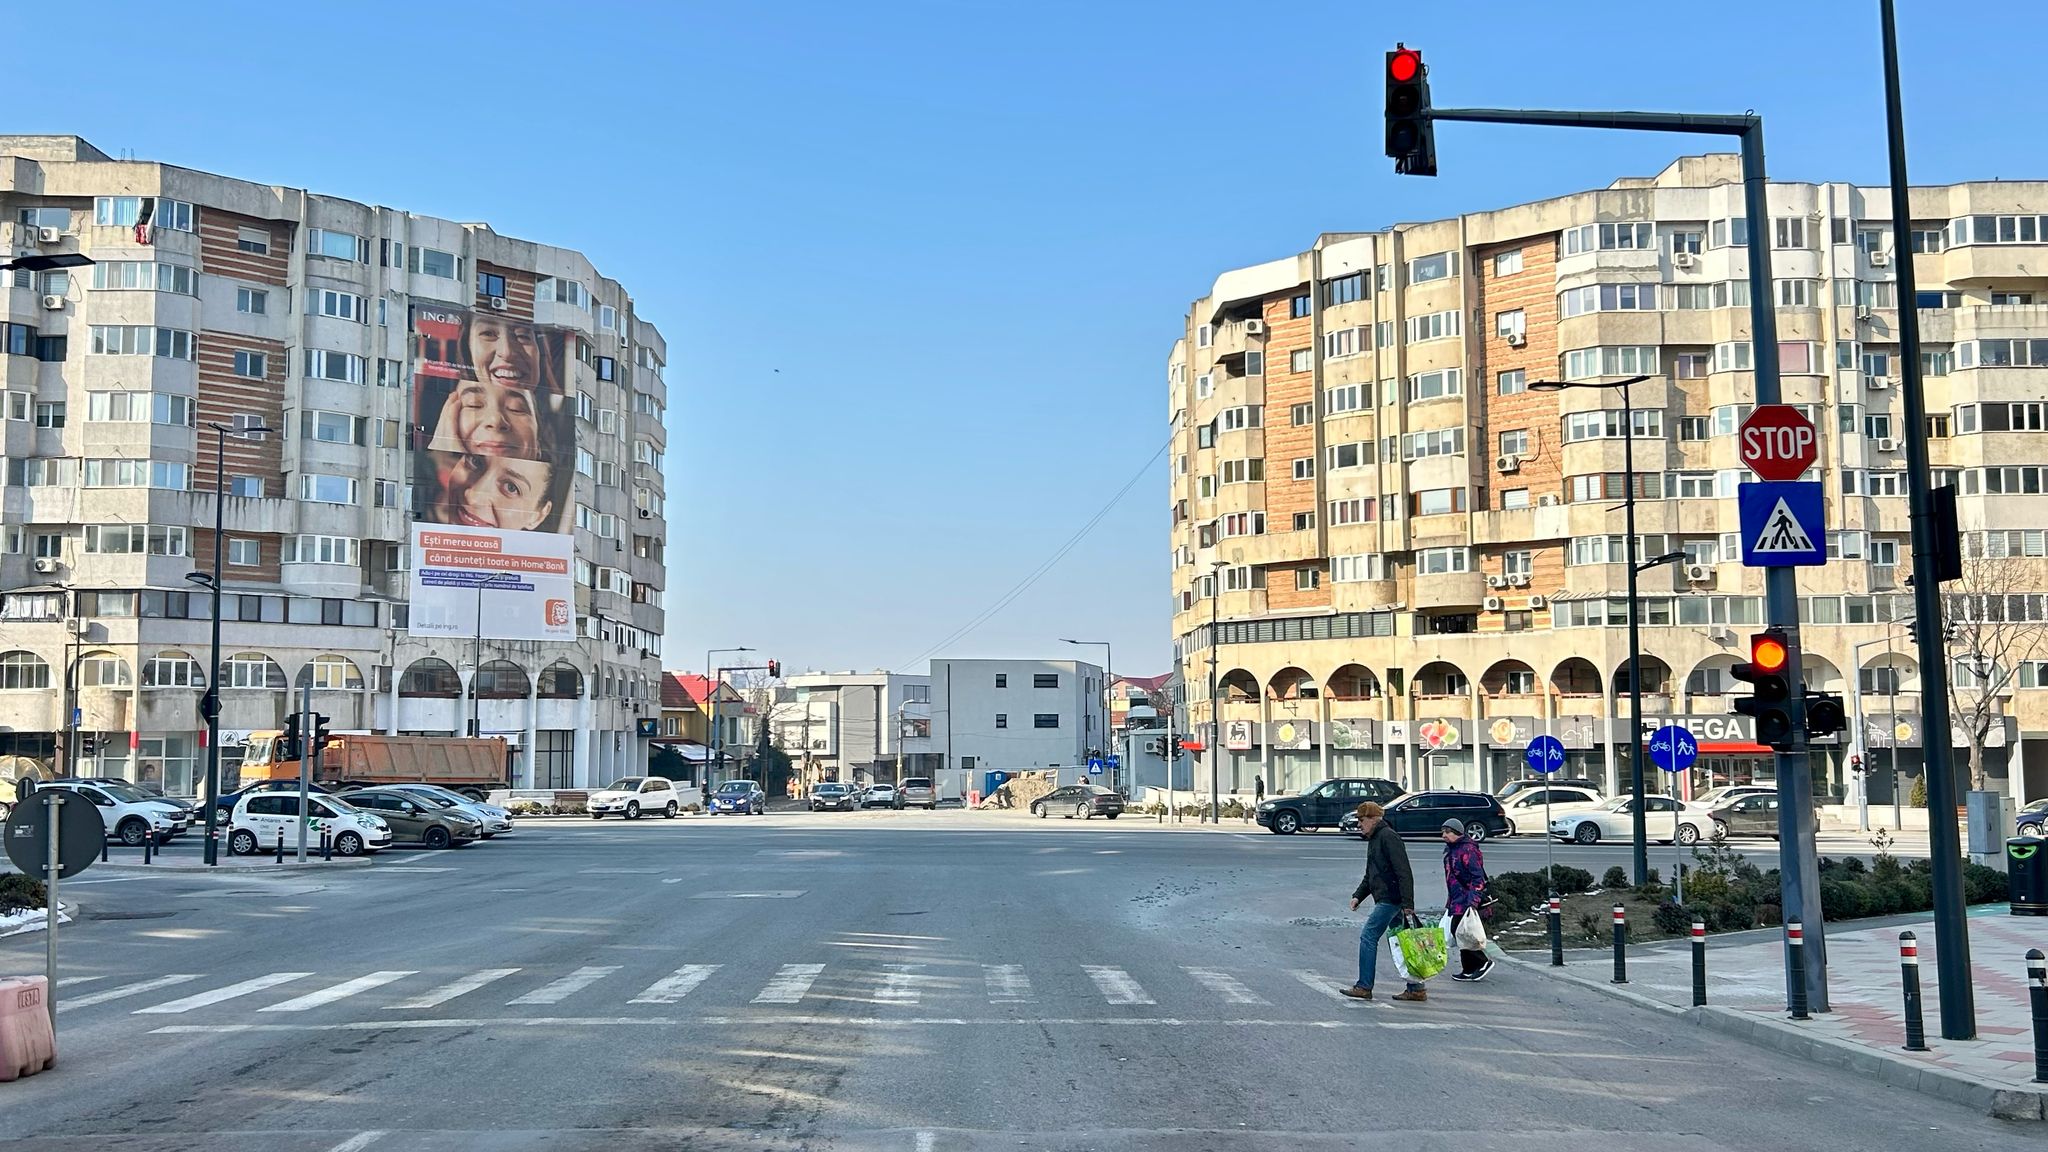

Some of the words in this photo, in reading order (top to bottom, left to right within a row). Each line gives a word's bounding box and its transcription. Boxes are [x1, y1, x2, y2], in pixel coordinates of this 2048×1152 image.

[422, 311, 445, 323] ING
[1744, 426, 1813, 460] STOP
[443, 538, 473, 547] mereu
[429, 554, 452, 563] când
[487, 556, 510, 567] toate
[511, 558, 520, 567] în
